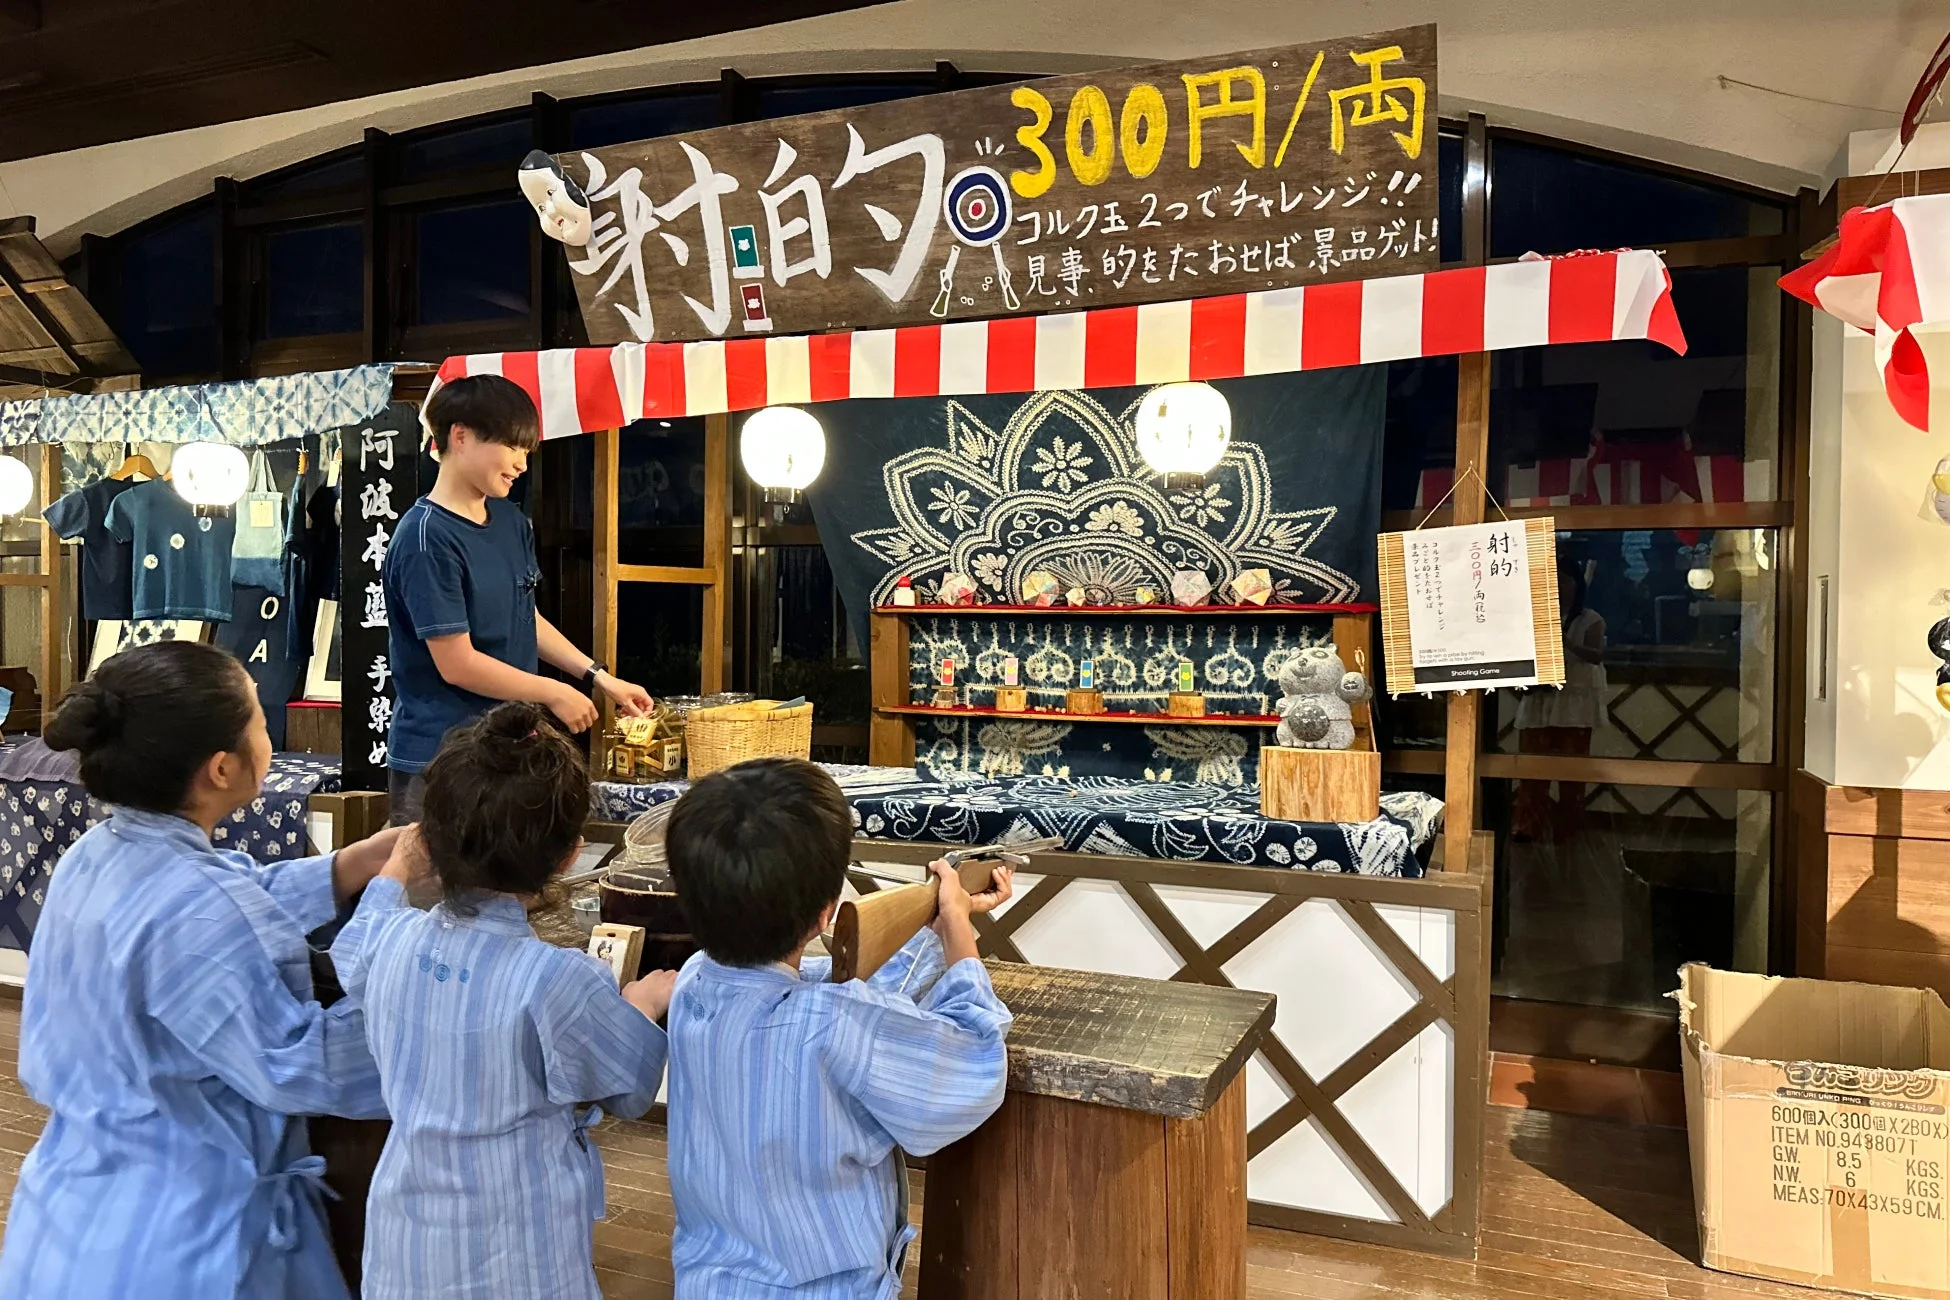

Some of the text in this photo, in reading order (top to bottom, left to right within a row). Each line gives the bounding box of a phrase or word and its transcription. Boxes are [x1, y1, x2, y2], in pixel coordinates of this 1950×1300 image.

[1010, 45, 1426, 198] 300円/両
[569, 123, 945, 343] 射的
[1486, 532, 1512, 577] 射的
[1772, 1126, 1809, 1145] ITEM
[1773, 1145, 1944, 1179] G.W. 8.5 KGS.
[1773, 1164, 1944, 1199] N.W. 6 KGS.
